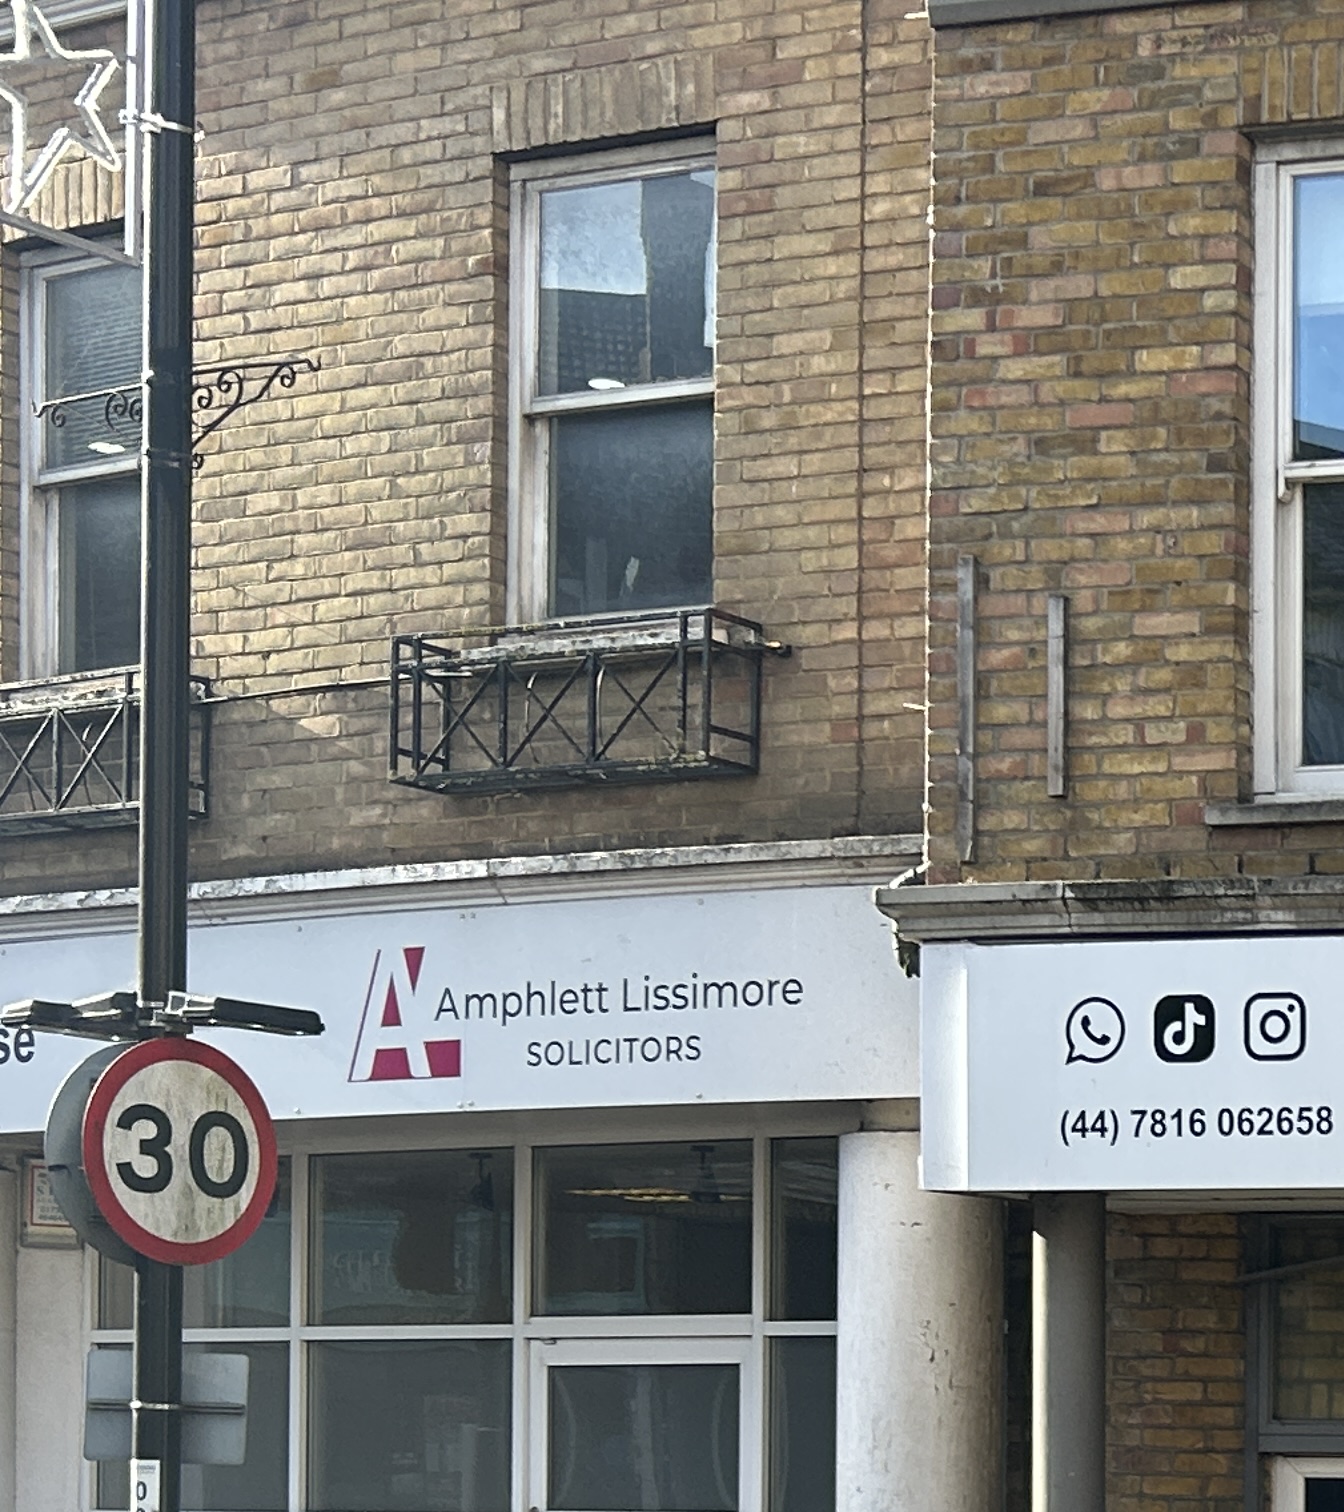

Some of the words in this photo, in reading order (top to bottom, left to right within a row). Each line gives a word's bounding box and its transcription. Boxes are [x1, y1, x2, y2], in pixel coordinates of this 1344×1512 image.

[433, 980, 609, 1027] Amphlett
[621, 973, 803, 1015] Lissimore
[526, 1034, 702, 1067] SOLICITORS
[1059, 1109, 1120, 1147] (44)
[1130, 1109, 1206, 1139] 7816
[1217, 1106, 1333, 1138] 062658
[115, 1103, 249, 1199] 30
